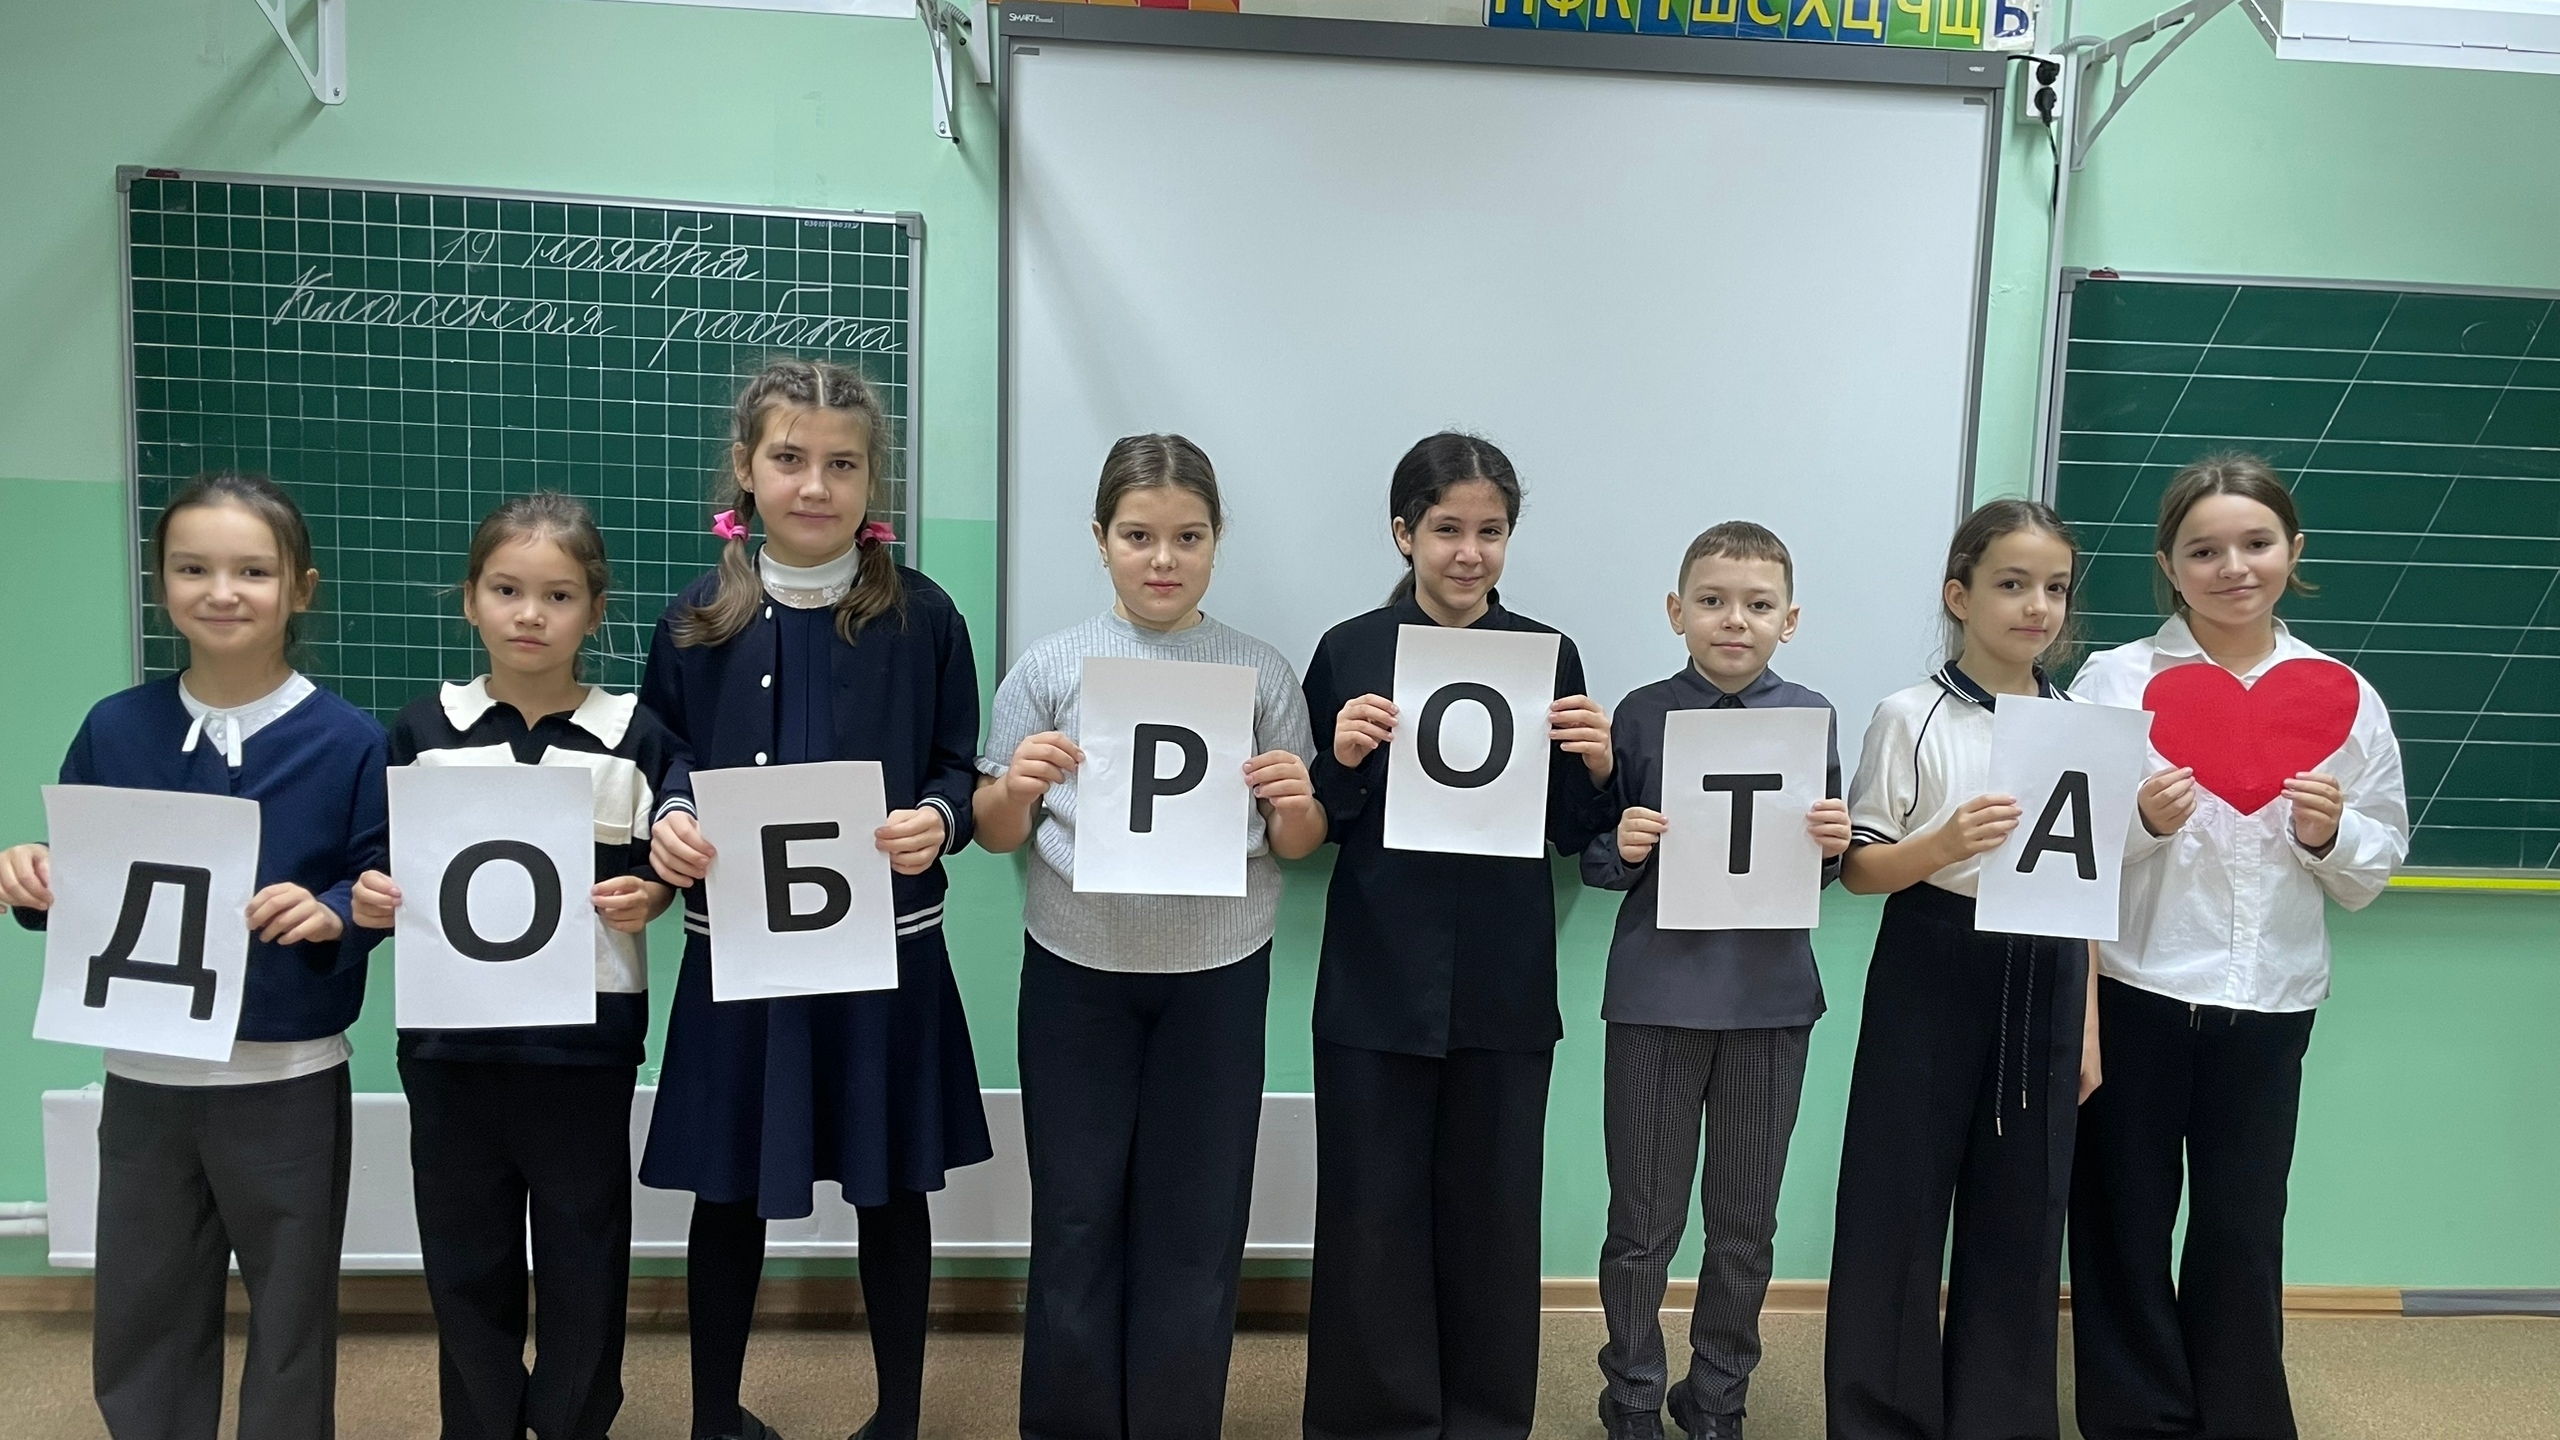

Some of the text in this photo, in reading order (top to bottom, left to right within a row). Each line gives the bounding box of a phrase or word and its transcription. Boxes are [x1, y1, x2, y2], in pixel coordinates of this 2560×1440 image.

[1008, 12, 1036, 22] SMART
[1842, 0, 1883, 39] Ц
[1896, 0, 1930, 34] Ч
[1938, 0, 1981, 45] Щ
[438, 223, 761, 299] 19 ноября
[271, 265, 903, 369] Классная работа
[1130, 724, 1208, 832] Р
[1417, 683, 1513, 788] О
[1703, 774, 1782, 874] Т
[2016, 771, 2097, 880] А
[440, 840, 561, 961] О
[761, 822, 851, 932] Б
[84, 861, 216, 1020] Д
